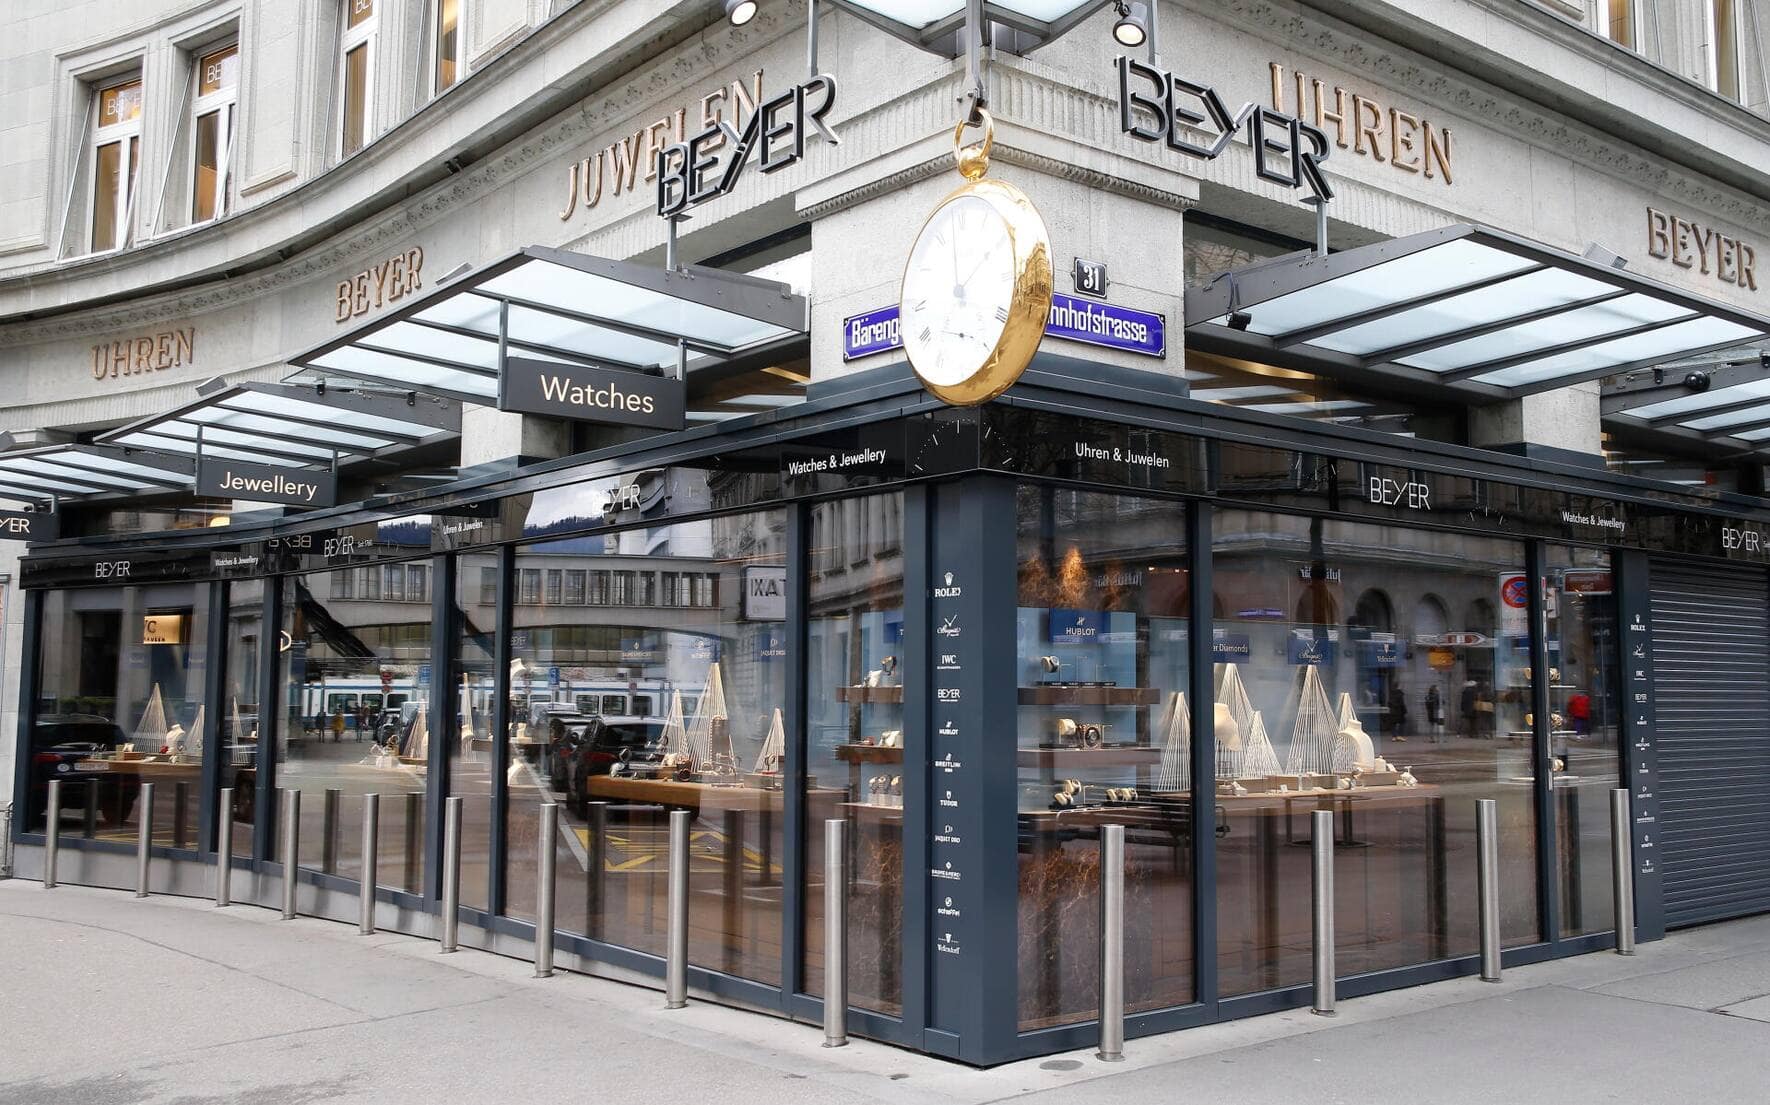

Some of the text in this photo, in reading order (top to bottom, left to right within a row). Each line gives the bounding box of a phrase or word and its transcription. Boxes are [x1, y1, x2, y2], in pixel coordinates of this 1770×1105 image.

[1115, 55, 1334, 203] BEYER
[656, 72, 841, 217] BEYER
[1647, 206, 1758, 292] BEYER
[334, 245, 425, 323] BEYER
[1082, 264, 1100, 292] 31
[1048, 300, 1147, 343] hnhofstrasse
[90, 326, 196, 381] UHREN
[540, 374, 654, 414] Watches
[789, 448, 886, 476] Watches & Jewellery
[1075, 442, 1169, 469] Uhren & Juwelen
[219, 471, 317, 501] Jewellery
[1370, 476, 1431, 511] BEYER
[1562, 511, 1626, 532] Watches & Jewellery
[324, 535, 354, 558] BEYER
[1722, 527, 1760, 553] BEYER
[95, 560, 130, 578] BEYER
[1066, 627, 1096, 636] HUBLOT
[941, 654, 957, 664] IWC
[938, 688, 960, 698] BEYER
